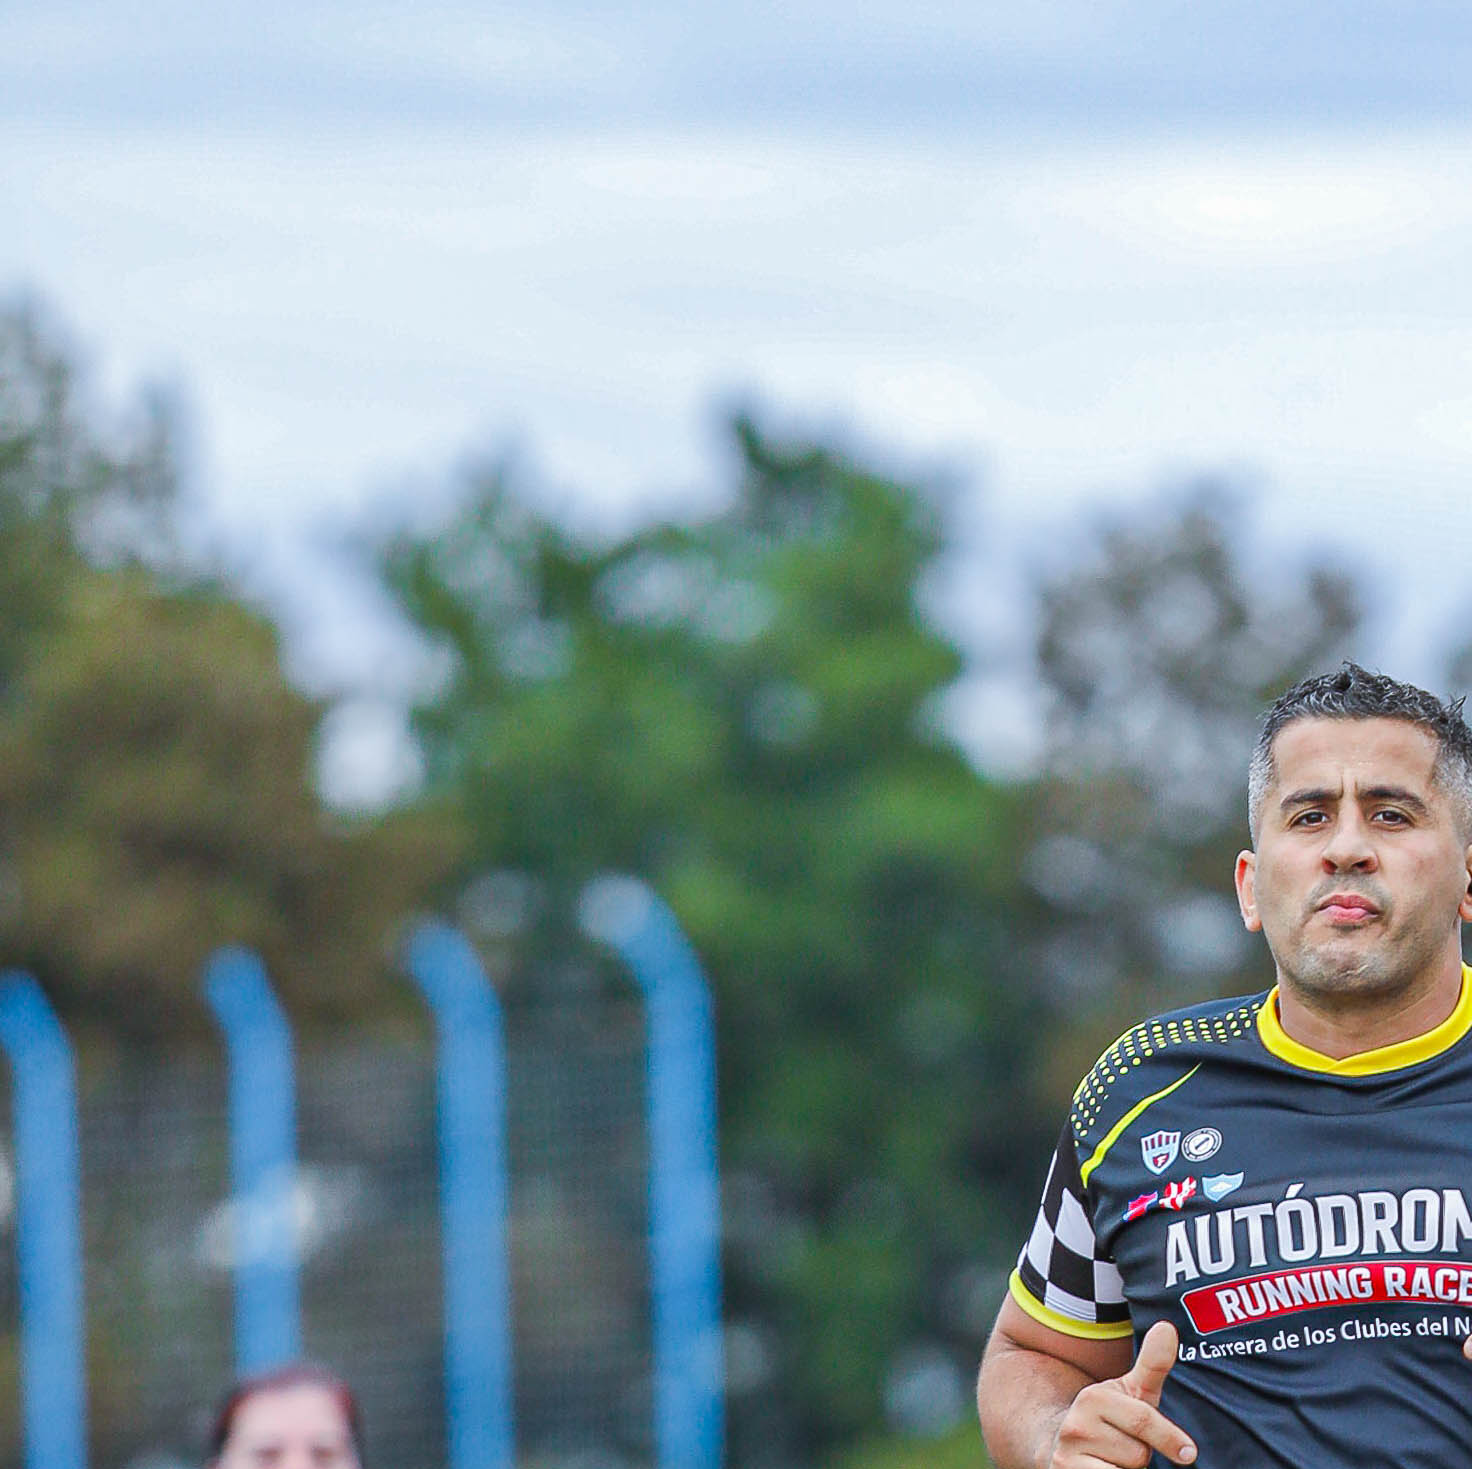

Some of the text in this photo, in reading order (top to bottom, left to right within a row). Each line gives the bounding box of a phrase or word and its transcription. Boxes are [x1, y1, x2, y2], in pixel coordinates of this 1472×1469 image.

[1215, 1266, 1373, 1324] RUNNING
[1200, 1337, 1267, 1359] Carrera
[1272, 1330, 1299, 1351] de
[1304, 1326, 1336, 1346] los
[1340, 1317, 1411, 1340] Clubes
[1416, 1317, 1448, 1336] del
